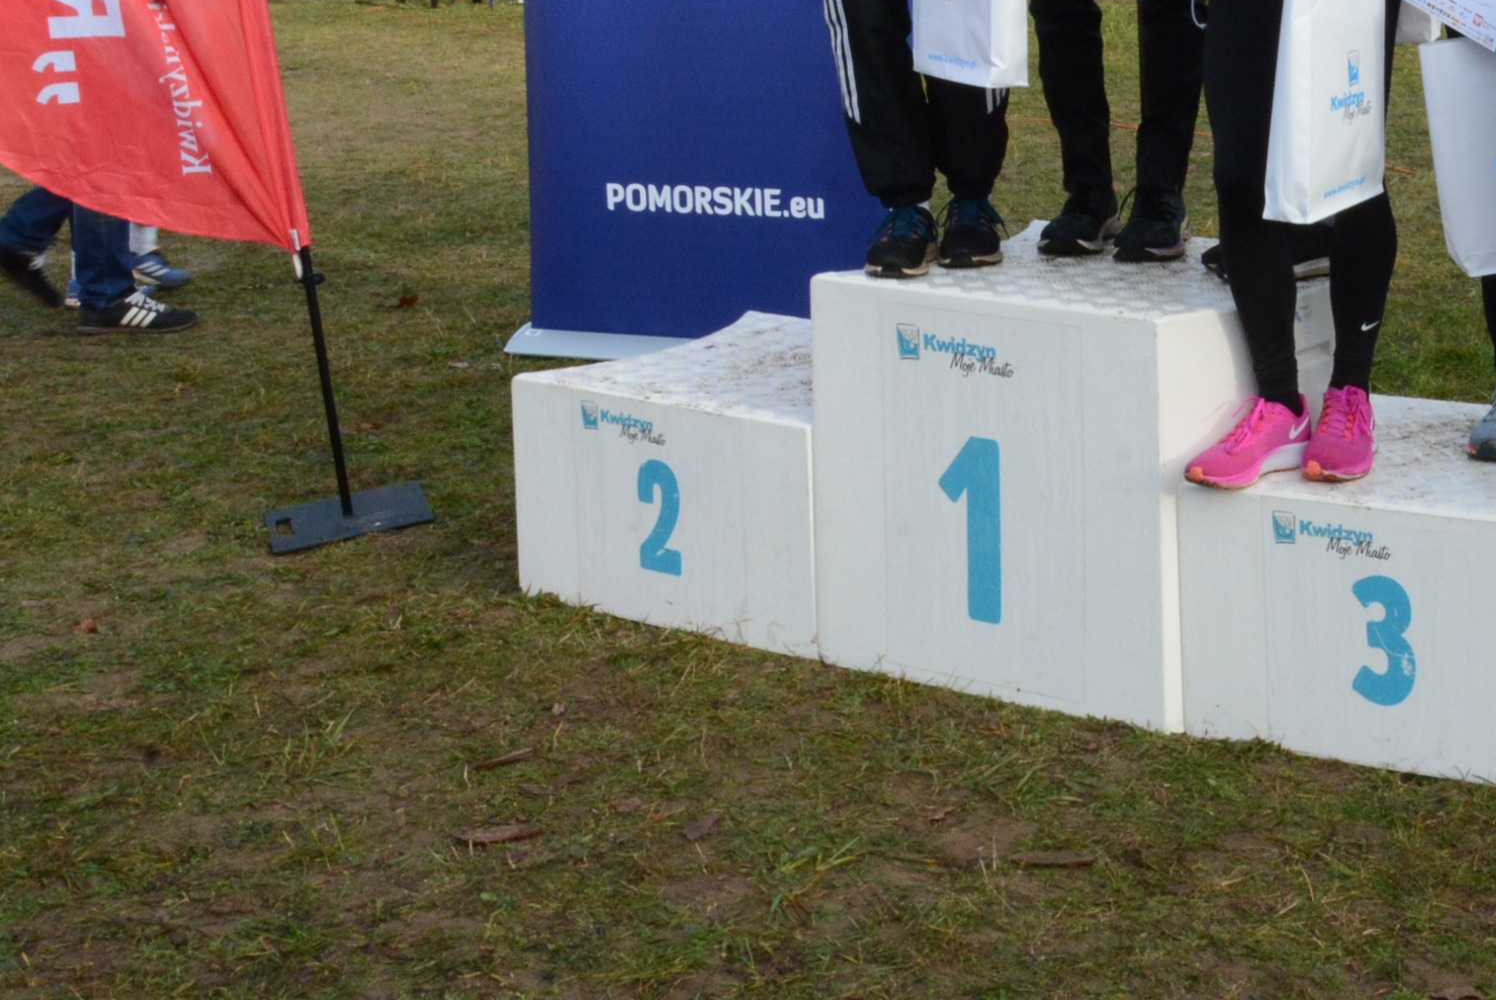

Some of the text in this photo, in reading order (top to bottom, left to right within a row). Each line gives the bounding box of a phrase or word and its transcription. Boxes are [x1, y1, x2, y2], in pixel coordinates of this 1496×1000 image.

[1330, 90, 1365, 112] Kwidzyn
[605, 182, 826, 220] POMORSKIE.eu
[922, 333, 997, 364] Kwidzyn
[950, 352, 1015, 378] Moje Miasto
[600, 408, 653, 433] Kwidzyn
[637, 459, 682, 577] 2
[938, 435, 1002, 624] 1
[1299, 520, 1373, 546] Kwidzyn
[1326, 537, 1392, 561] Moje Miasto
[1352, 575, 1417, 706] 3
